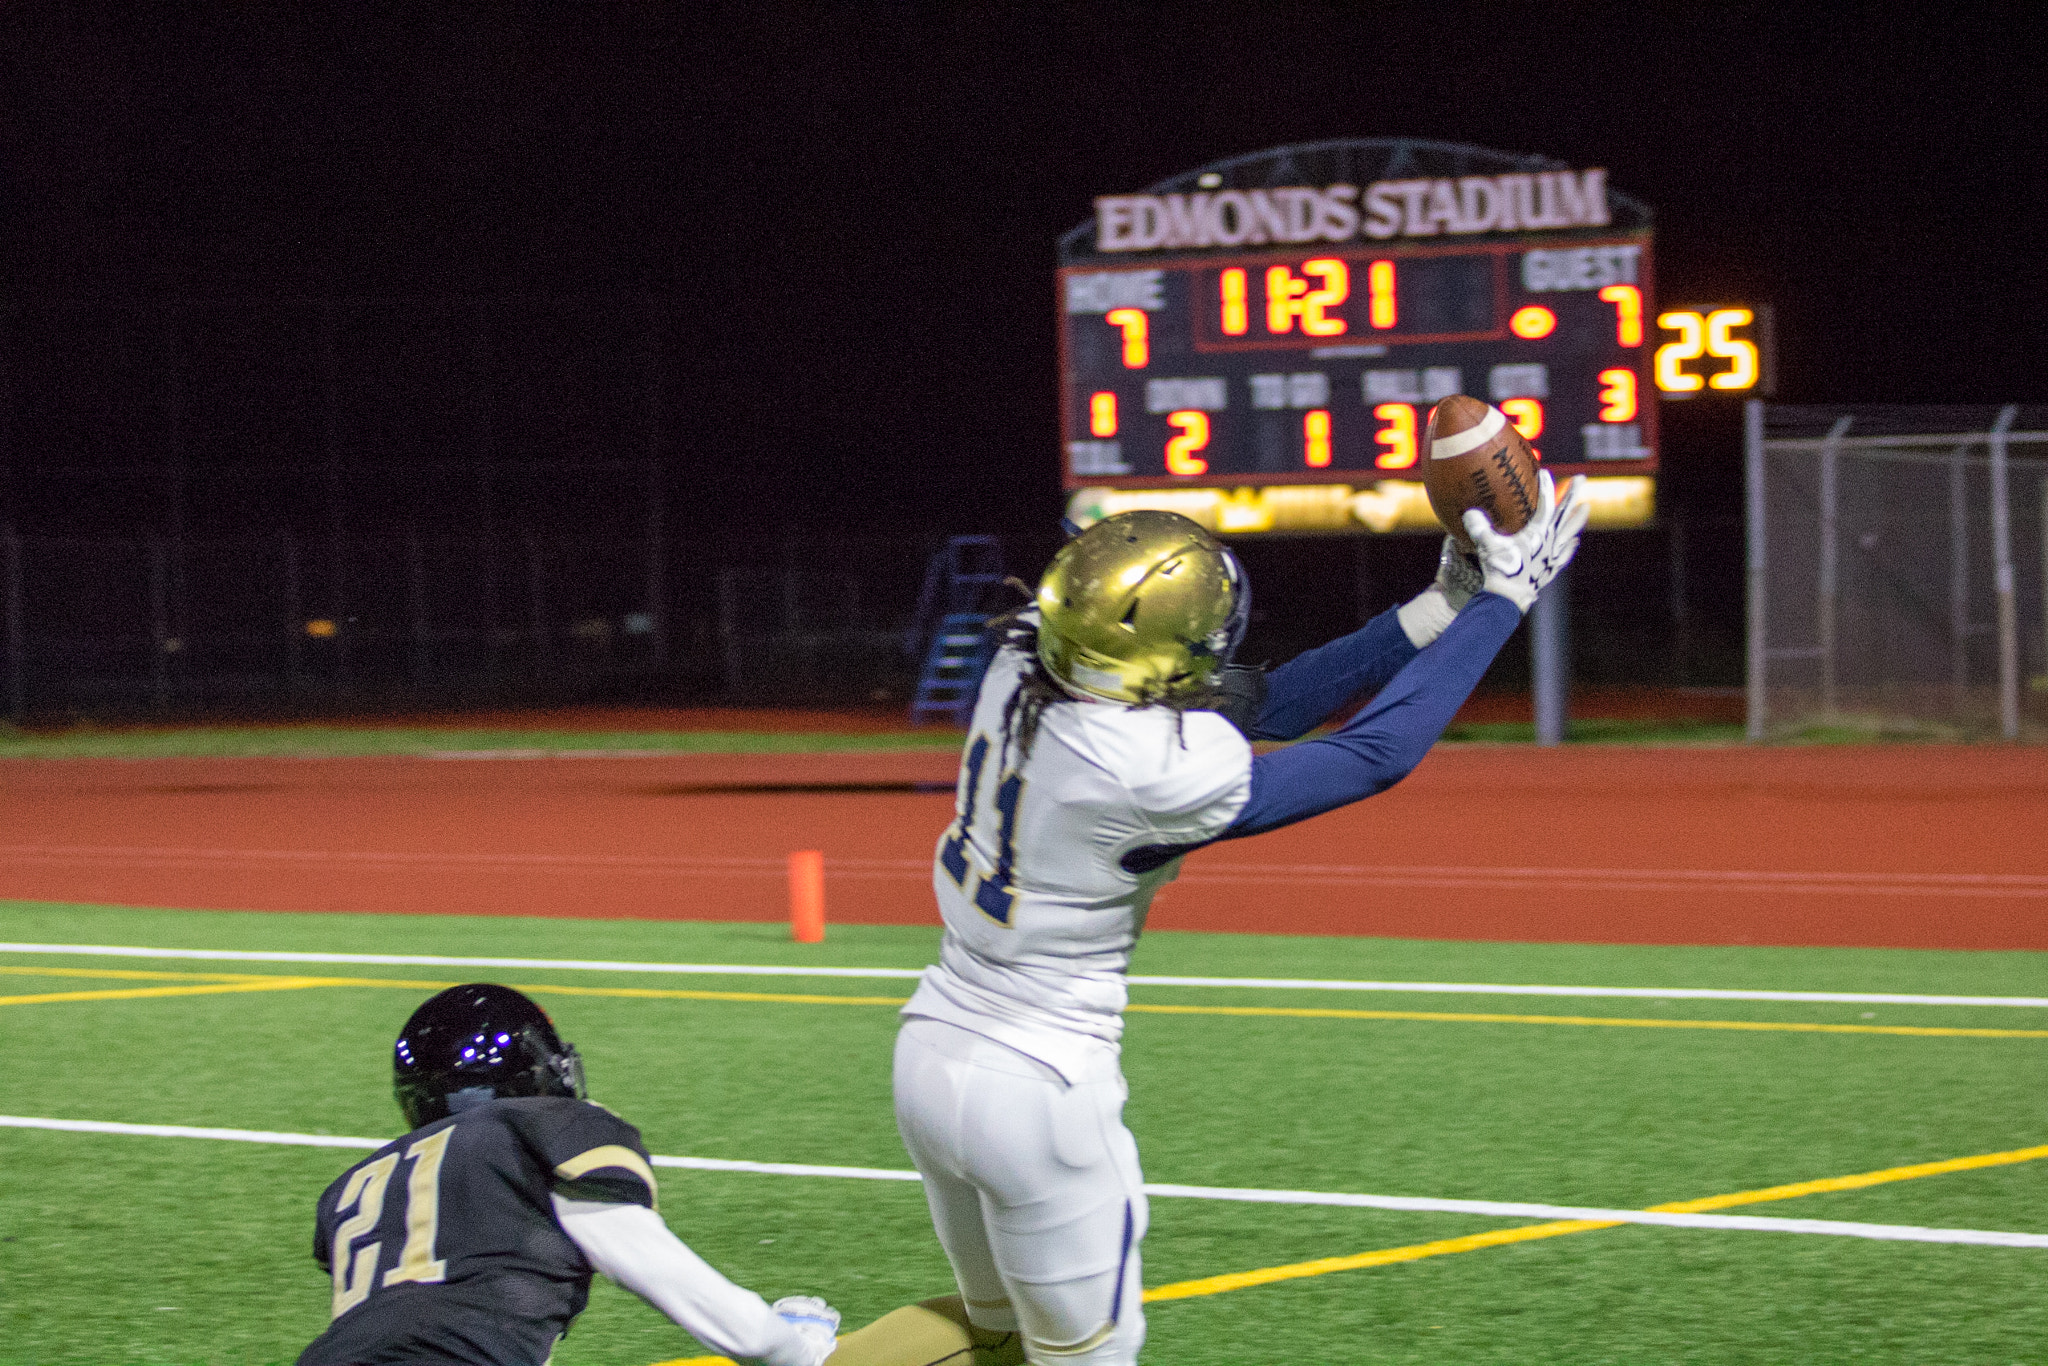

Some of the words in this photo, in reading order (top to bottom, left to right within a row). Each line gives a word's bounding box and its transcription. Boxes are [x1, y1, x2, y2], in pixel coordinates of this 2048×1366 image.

[1096, 185, 1359, 250] EDMONDS
[1363, 170, 1609, 239] STADIUM
[1524, 245, 1641, 292] GUEST
[1105, 308, 1149, 369] 7
[1598, 284, 1645, 348] 7
[1654, 307, 1759, 392] 25
[1089, 391, 1118, 438] 1
[1597, 367, 1639, 423] 3
[1164, 410, 1212, 476] 2
[936, 730, 1028, 929] 11
[331, 1124, 456, 1321] 21
